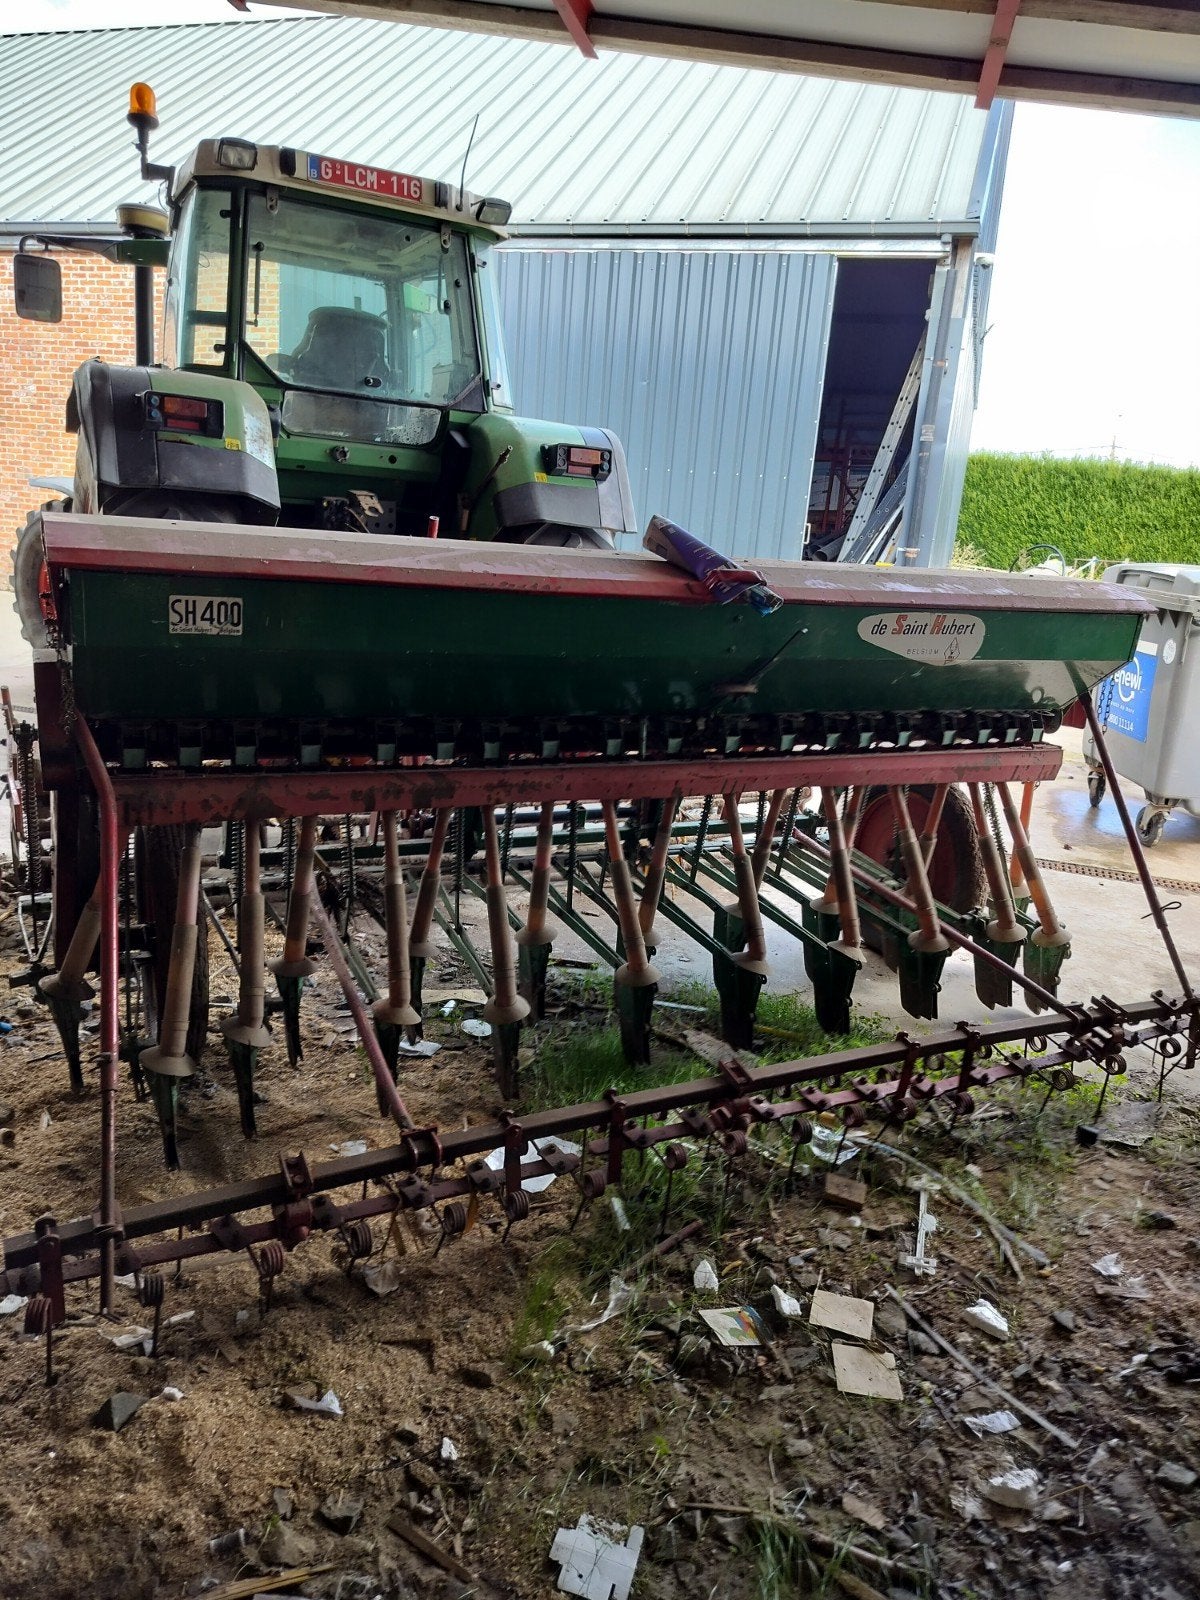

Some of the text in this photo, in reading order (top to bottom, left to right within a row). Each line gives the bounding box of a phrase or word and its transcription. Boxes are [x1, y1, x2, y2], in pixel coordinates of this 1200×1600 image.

[310, 168, 318, 178] B
[170, 598, 241, 627] SH 400
[870, 614, 976, 635] de Saint Hubert
